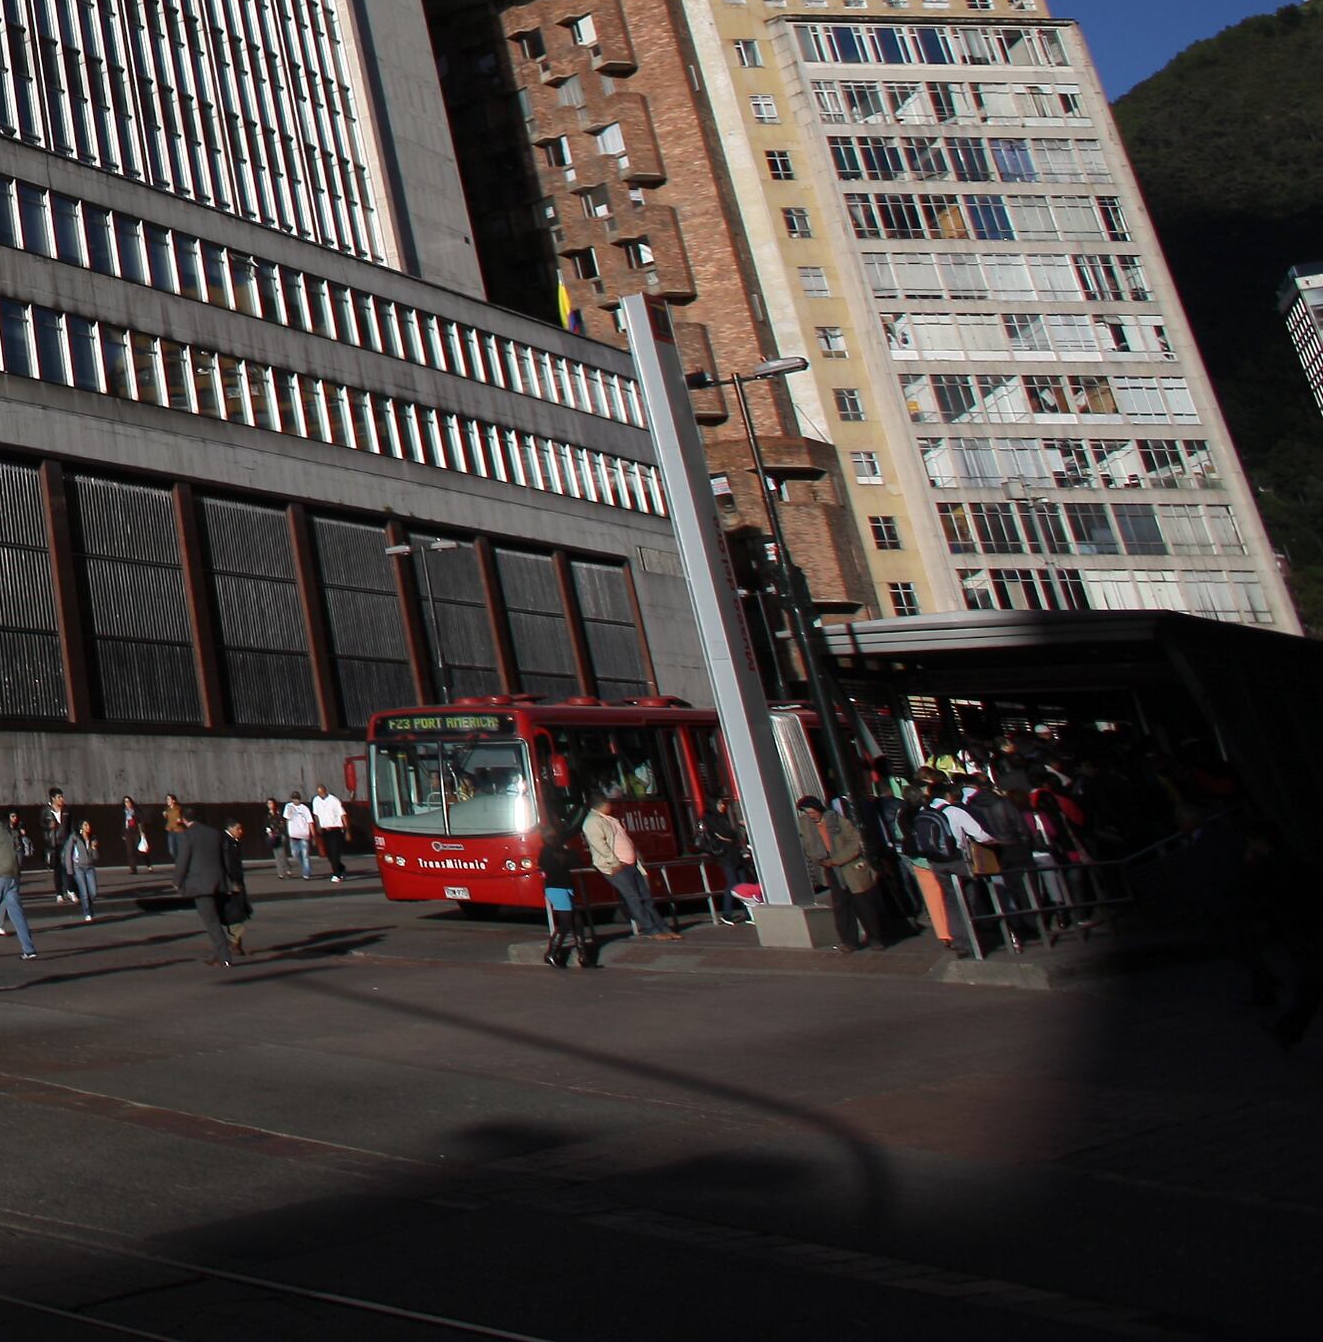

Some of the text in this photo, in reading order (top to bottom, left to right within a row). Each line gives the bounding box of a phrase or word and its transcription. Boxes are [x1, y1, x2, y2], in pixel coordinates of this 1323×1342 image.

[720, 558, 737, 591] del
[731, 598, 756, 672] Museo
[388, 718, 411, 730] F23
[413, 717, 443, 729] PORT
[621, 810, 667, 832] sMilenio
[417, 857, 486, 870] TransMilenio
